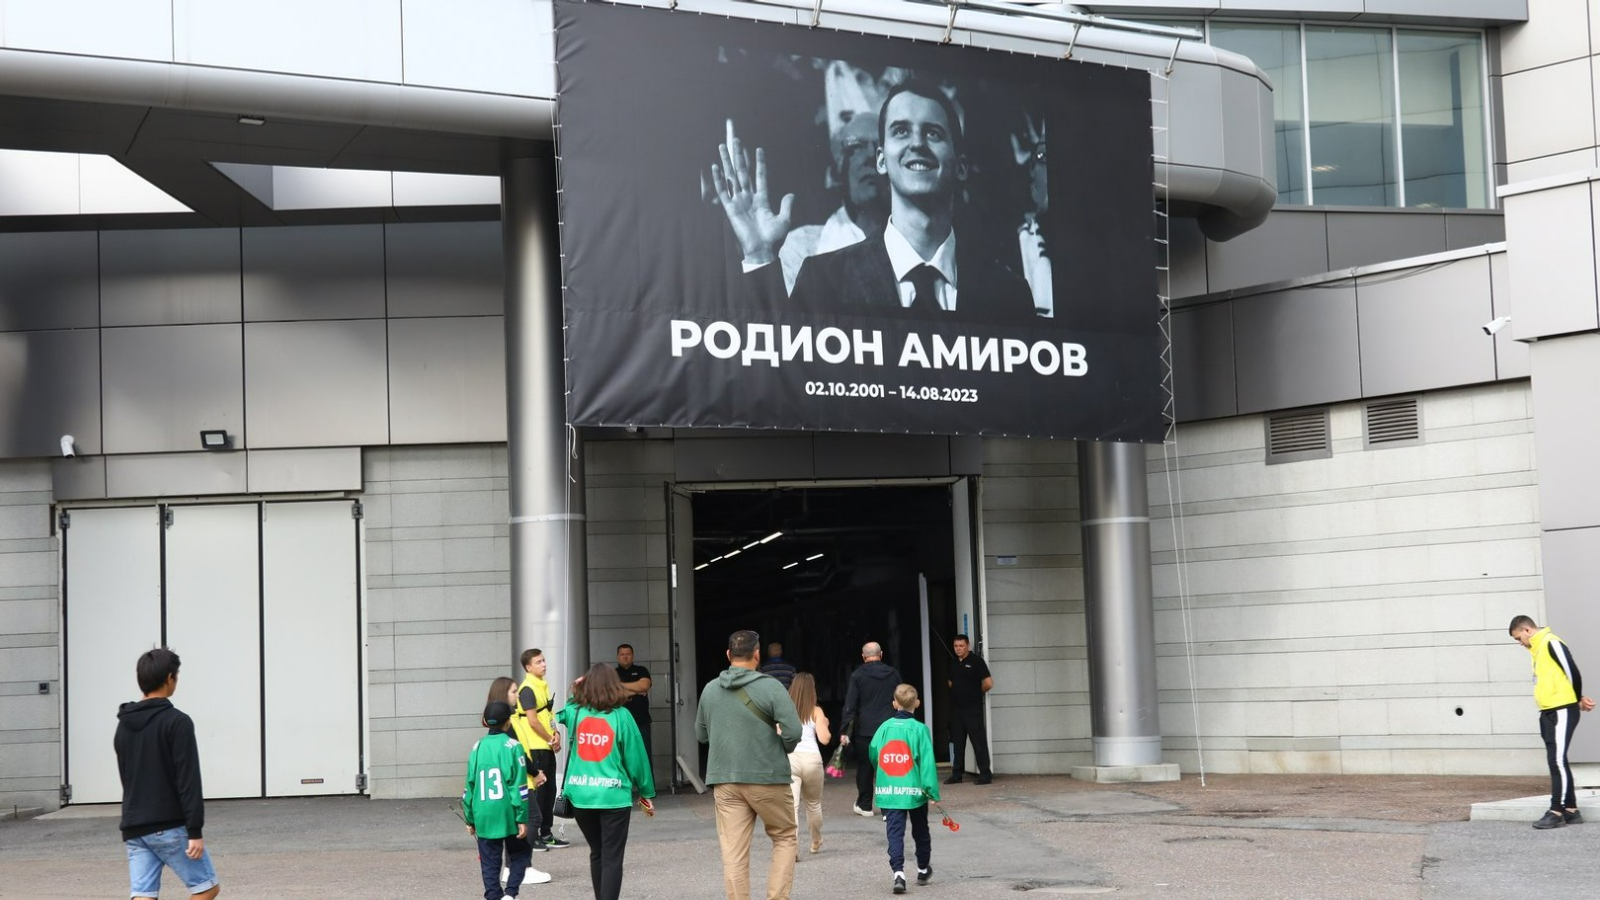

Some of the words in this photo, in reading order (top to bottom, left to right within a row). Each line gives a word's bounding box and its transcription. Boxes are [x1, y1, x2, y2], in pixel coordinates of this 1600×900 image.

[671, 319, 884, 367] РОДИОН
[898, 332, 1089, 377] АМИРОВ
[805, 381, 885, 398] 02.10.2001
[899, 385, 978, 402] 14.08.2023
[578, 732, 609, 747] STOP
[883, 753, 910, 764] STOP
[480, 767, 504, 801] 13
